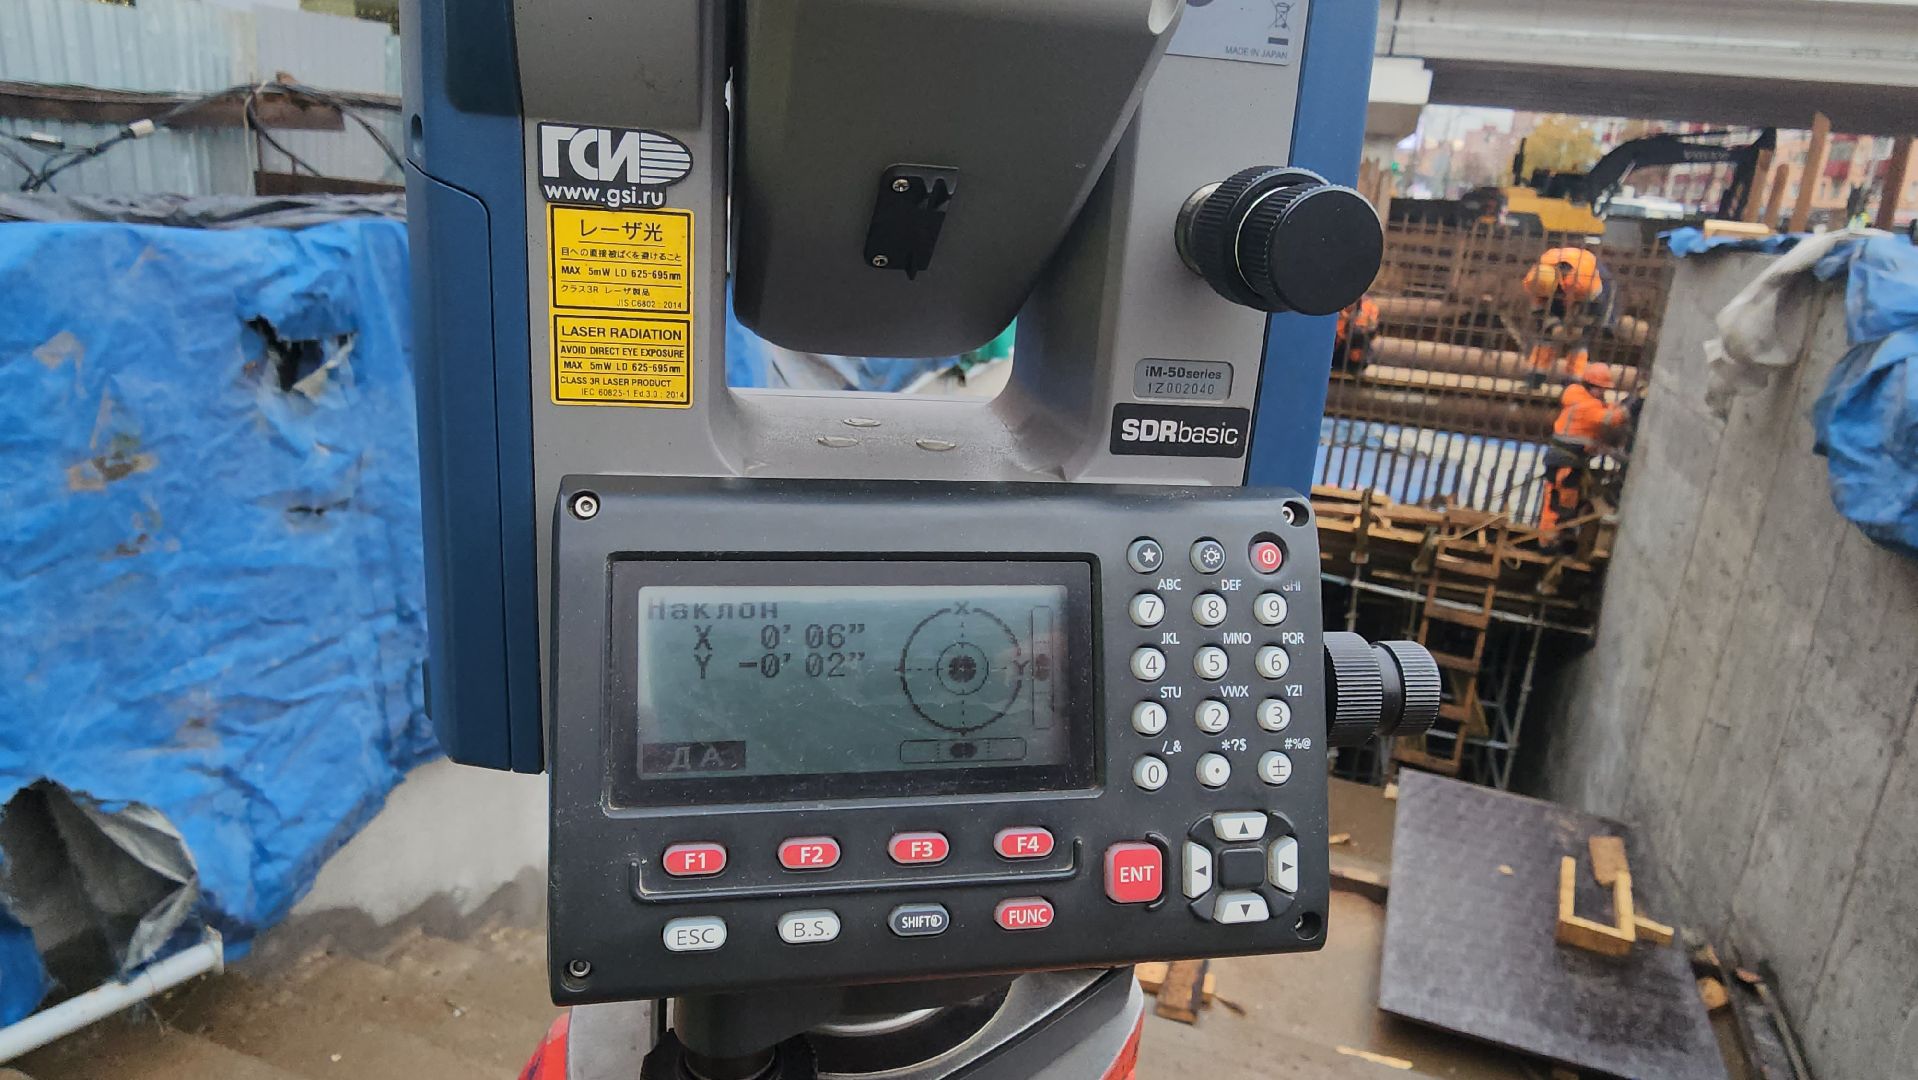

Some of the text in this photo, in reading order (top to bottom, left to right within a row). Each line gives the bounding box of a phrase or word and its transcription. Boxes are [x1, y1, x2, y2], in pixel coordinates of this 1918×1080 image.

[544, 184, 664, 207] www.gsi.ru
[580, 218, 663, 242] レーザ光
[561, 265, 681, 280] MAX 5mW LD 625-695nm
[561, 284, 599, 294] クラス3R
[663, 301, 682, 309] 2014
[561, 325, 682, 341] LASER RADIATION
[560, 345, 684, 358] AVOID DIRECT EYE EXPOSURE
[563, 361, 681, 373] MAX 5mW LD 625-695nm
[560, 376, 587, 385] CLASS
[602, 378, 630, 386] LASER
[631, 379, 672, 388] PRODUCT
[581, 388, 595, 396] IEC
[666, 391, 685, 399] 2014
[1121, 418, 1239, 445] SDRbasic
[1157, 578, 1182, 591] ABC
[1221, 579, 1242, 591] DEF
[648, 599, 779, 620] Наклон
[1145, 600, 1156, 618] 7
[1207, 600, 1220, 618] 8
[1269, 600, 1280, 617] 9
[1160, 633, 1180, 645] JKL
[1223, 632, 1252, 644] MNO
[1282, 632, 1305, 645] PQR
[1145, 655, 1158, 673] 4
[1208, 654, 1220, 672] 5
[1271, 653, 1282, 671] 6
[1160, 686, 1182, 698] STU
[1220, 686, 1249, 698] VWX
[1148, 709, 1156, 728] 1
[1211, 708, 1222, 726] 2
[1273, 706, 1283, 725] 3
[1284, 737, 1312, 750] #%@
[1148, 765, 1159, 784] 0
[910, 841, 933, 858] F3
[1017, 836, 1040, 853] F4
[684, 852, 708, 870] F1
[800, 846, 823, 864] F2
[1120, 865, 1154, 883] ENT
[901, 915, 931, 929] SHIFT
[1008, 907, 1048, 924] FUNC
[676, 927, 715, 946] ESC
[793, 920, 830, 938] B.S.
